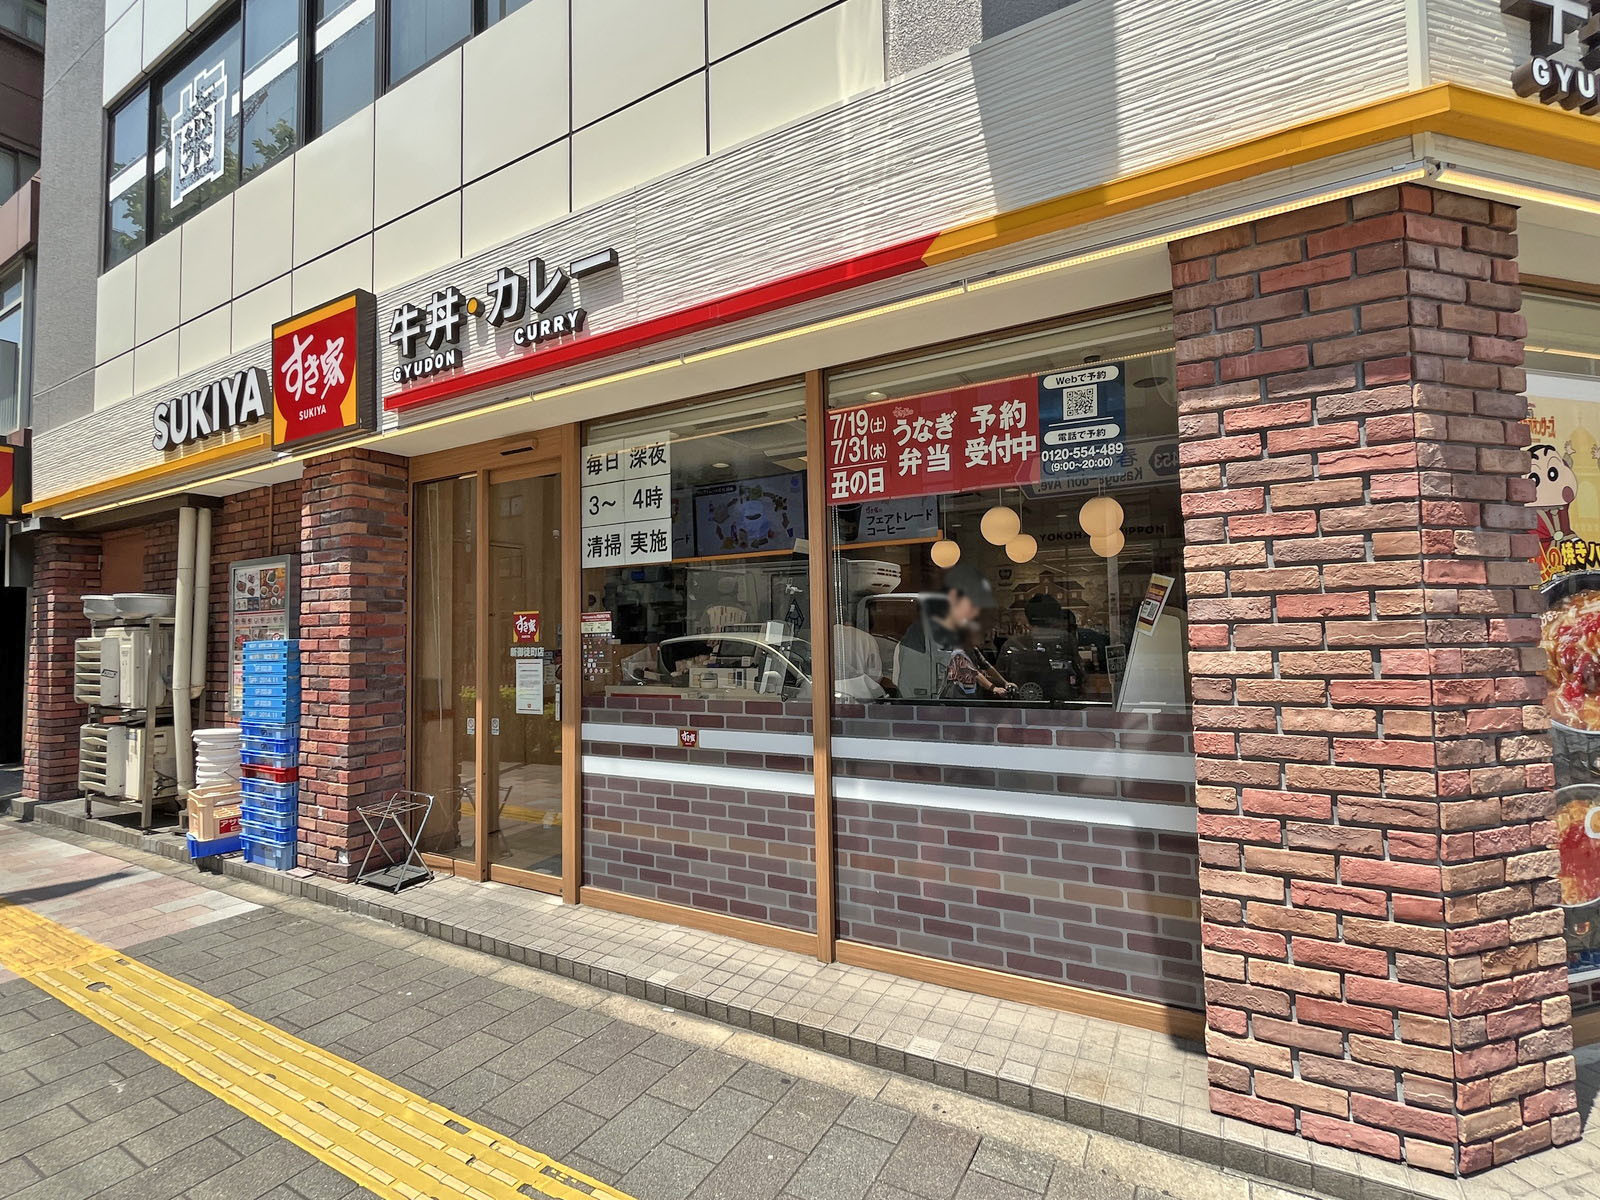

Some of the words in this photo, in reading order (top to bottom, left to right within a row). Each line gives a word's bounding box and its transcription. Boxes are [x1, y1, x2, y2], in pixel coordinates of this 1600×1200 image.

[513, 309, 581, 345] CURRY
[280, 333, 346, 402] すき家
[392, 349, 456, 383] GYUDON
[1055, 370, 1107, 386] Webで予約
[152, 366, 266, 451] SUKIYA
[298, 404, 327, 421] SUKIYA
[970, 399, 1027, 435] 予約
[892, 410, 958, 446] うなぎ
[1057, 428, 1107, 442] 電話で予約
[586, 453, 619, 476] 毎日
[629, 441, 667, 470] 深夜
[898, 443, 950, 476] 弁当
[964, 431, 1037, 469] 受付中
[1041, 442, 1124, 462] 0120-554-489
[632, 485, 664, 510] 4時
[831, 466, 885, 499] 丑の日
[866, 508, 934, 526] フェアトレード
[867, 524, 906, 537] コーヒー
[586, 533, 622, 558] 清掃
[630, 528, 668, 555] 実施
[515, 615, 537, 634] すき家
